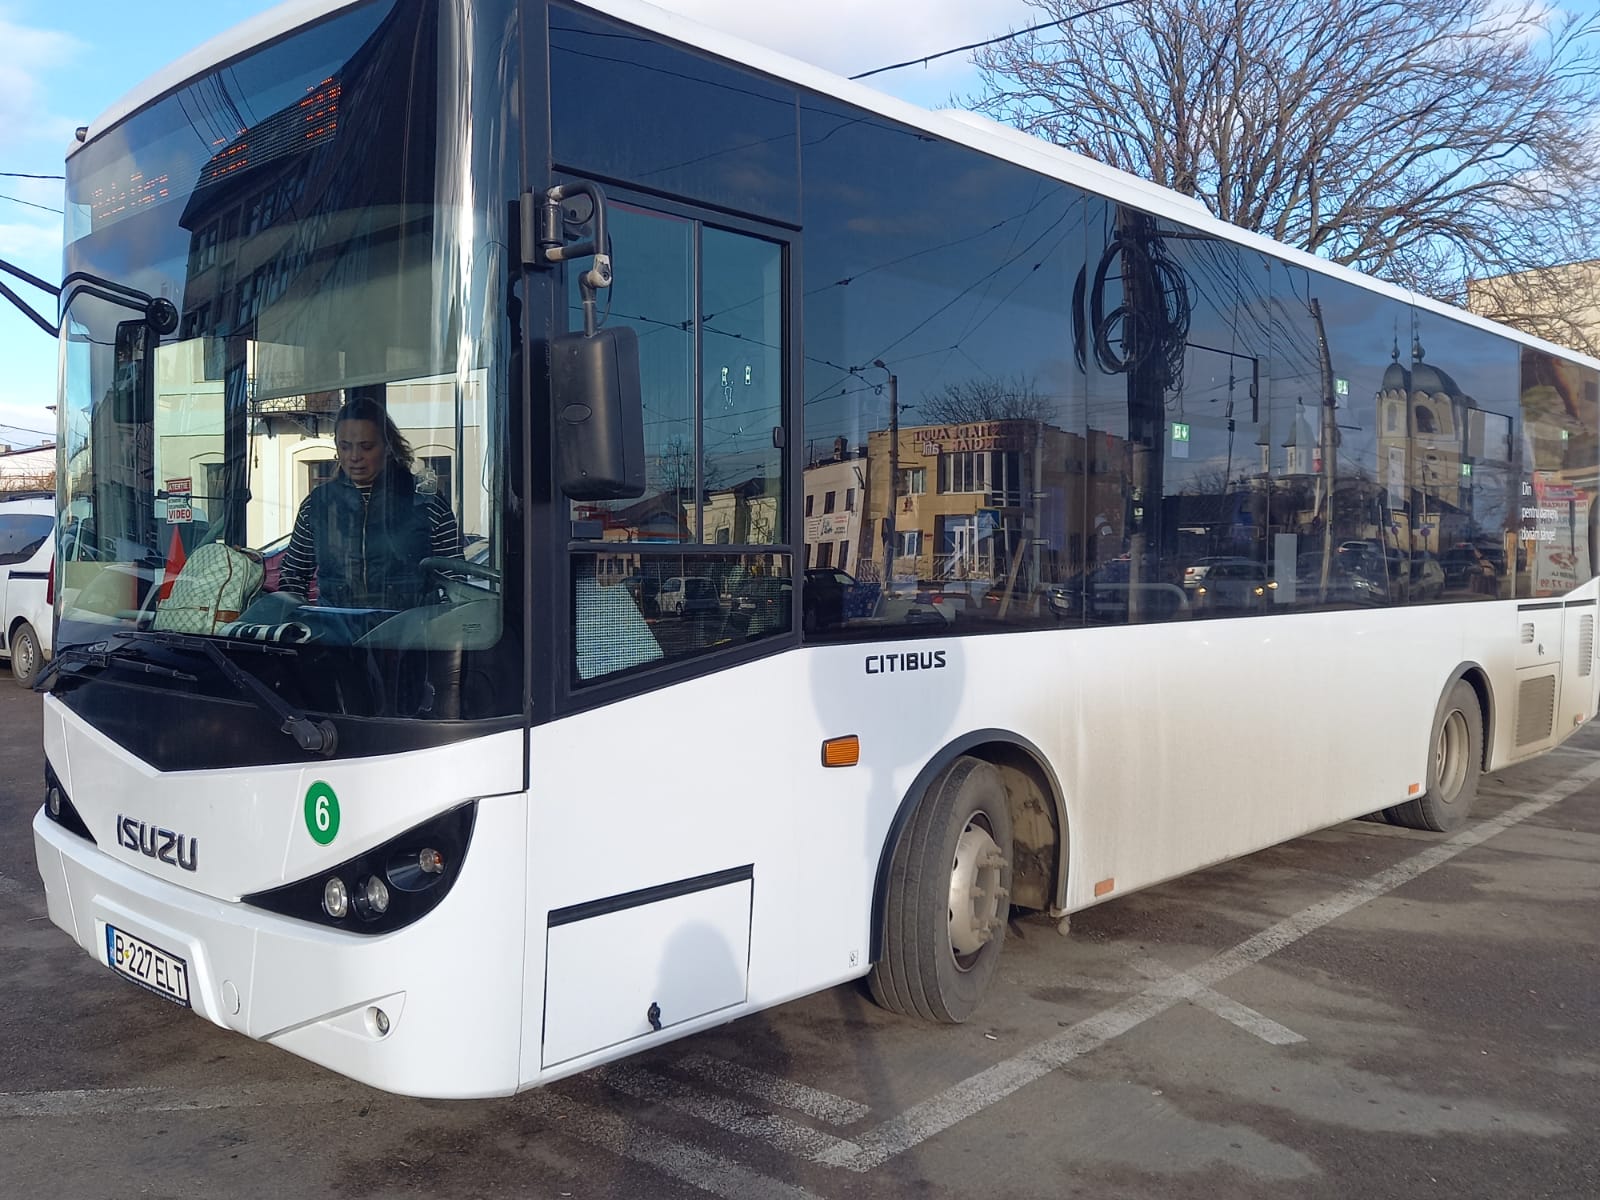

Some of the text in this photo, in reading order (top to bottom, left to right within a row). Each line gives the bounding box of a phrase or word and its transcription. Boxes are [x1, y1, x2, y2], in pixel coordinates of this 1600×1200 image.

[168, 509, 191, 519] VIDEO
[866, 650, 946, 674] CITIBUS
[315, 795, 330, 831] 6
[116, 813, 199, 872] ISUZU
[115, 934, 125, 966] B
[128, 942, 152, 980] 227
[155, 955, 182, 996] ELT
